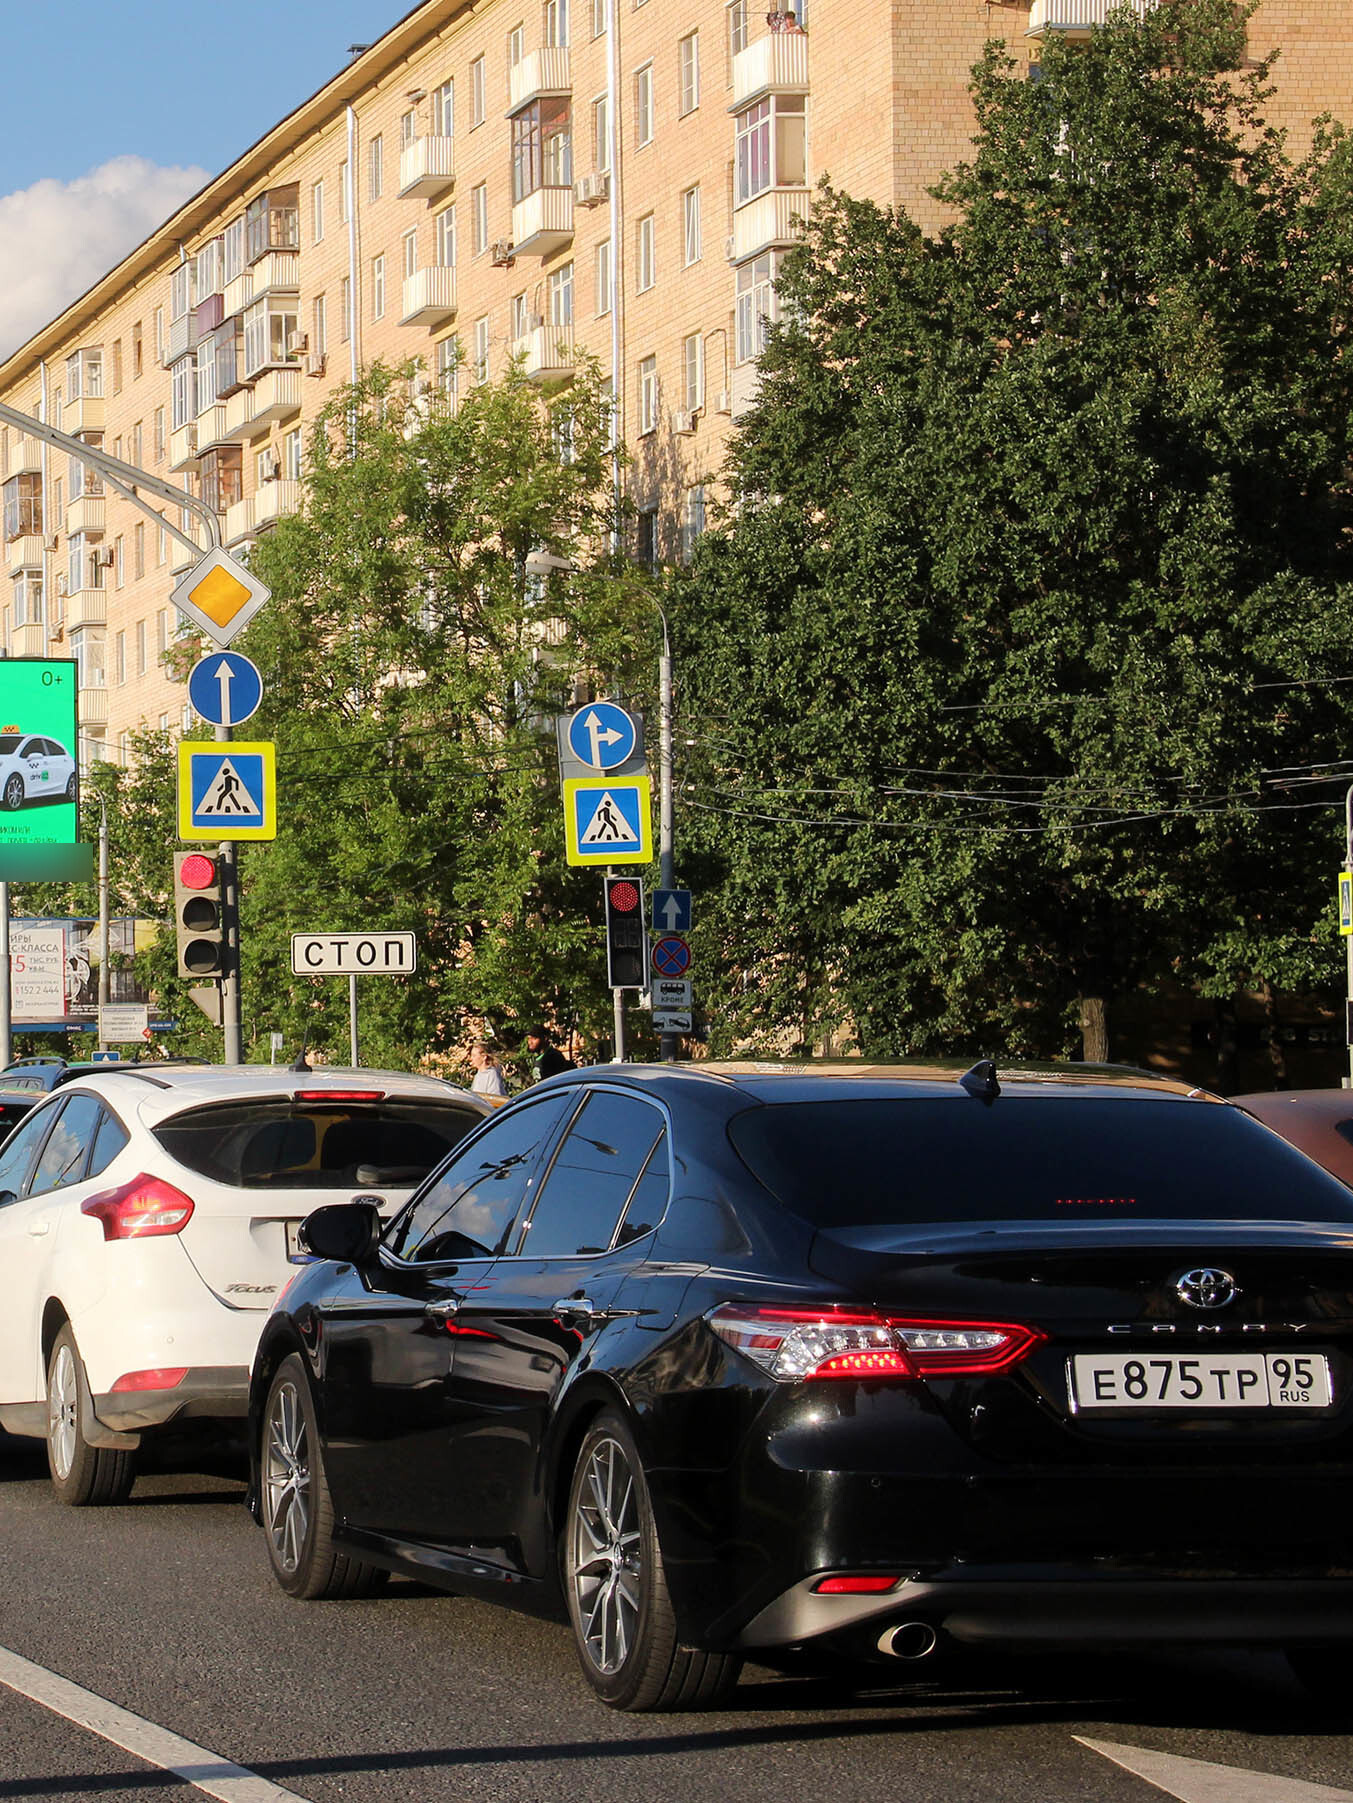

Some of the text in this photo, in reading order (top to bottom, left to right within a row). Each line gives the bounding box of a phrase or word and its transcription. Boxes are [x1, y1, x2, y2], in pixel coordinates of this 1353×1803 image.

[41, 671, 63, 687] 0+
[304, 941, 404, 966] СТОП
[1272, 1358, 1314, 1389] 95
[1280, 1390, 1310, 1402] RUS
